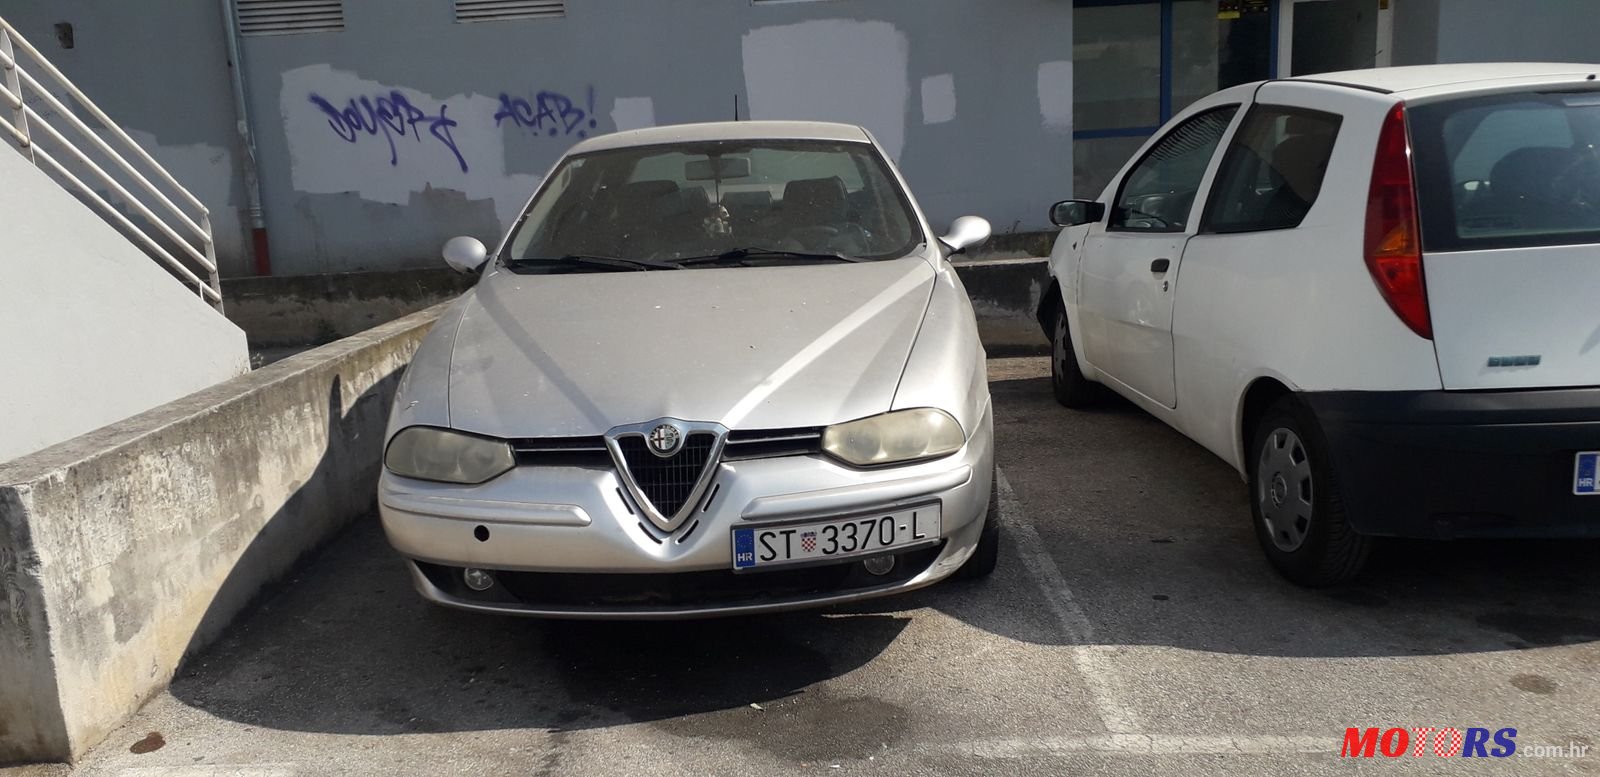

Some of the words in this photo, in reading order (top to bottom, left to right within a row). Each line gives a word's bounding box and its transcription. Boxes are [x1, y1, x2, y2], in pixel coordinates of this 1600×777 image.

[1578, 477, 1594, 487] HR
[737, 551, 753, 562] HR
[759, 529, 797, 562] ST
[821, 511, 925, 555] 3370-L
